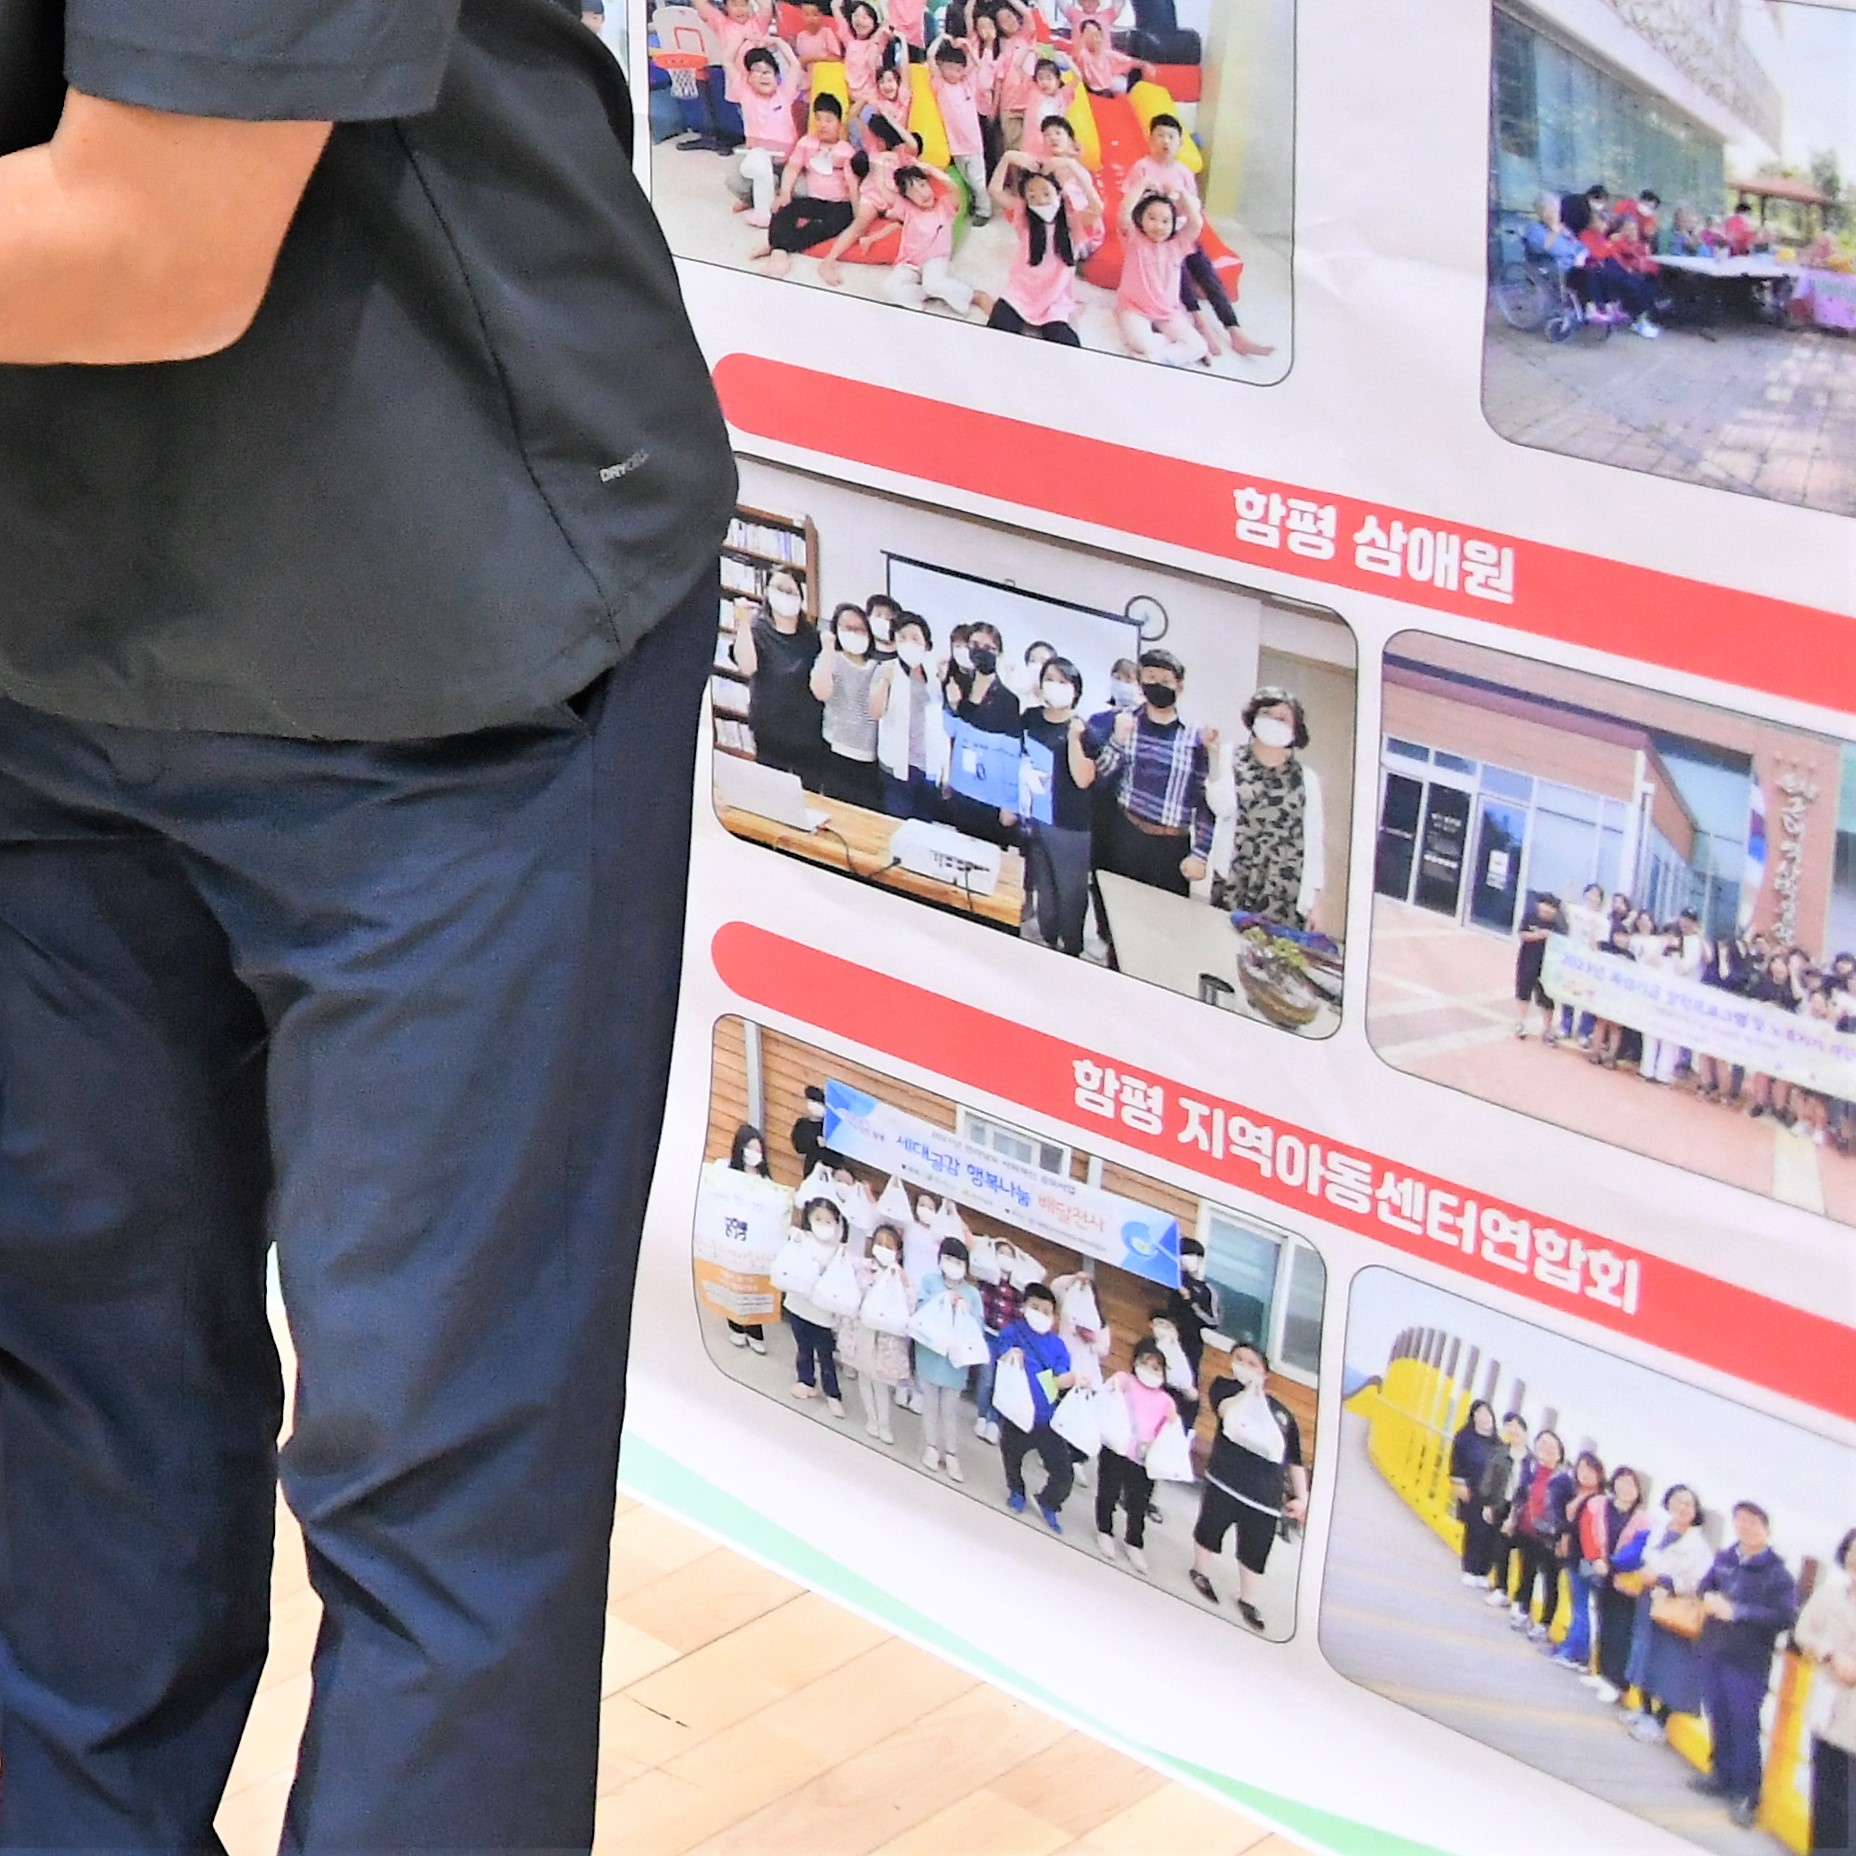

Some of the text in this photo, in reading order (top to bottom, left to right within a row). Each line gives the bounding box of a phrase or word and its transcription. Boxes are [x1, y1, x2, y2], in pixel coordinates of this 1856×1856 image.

[1232, 485, 1516, 605] 함평 삼애원
[896, 1135, 961, 1177] 세대공감
[1071, 1058, 1164, 1136] 함평
[1177, 1096, 1641, 1315] 지역아동센터연합회
